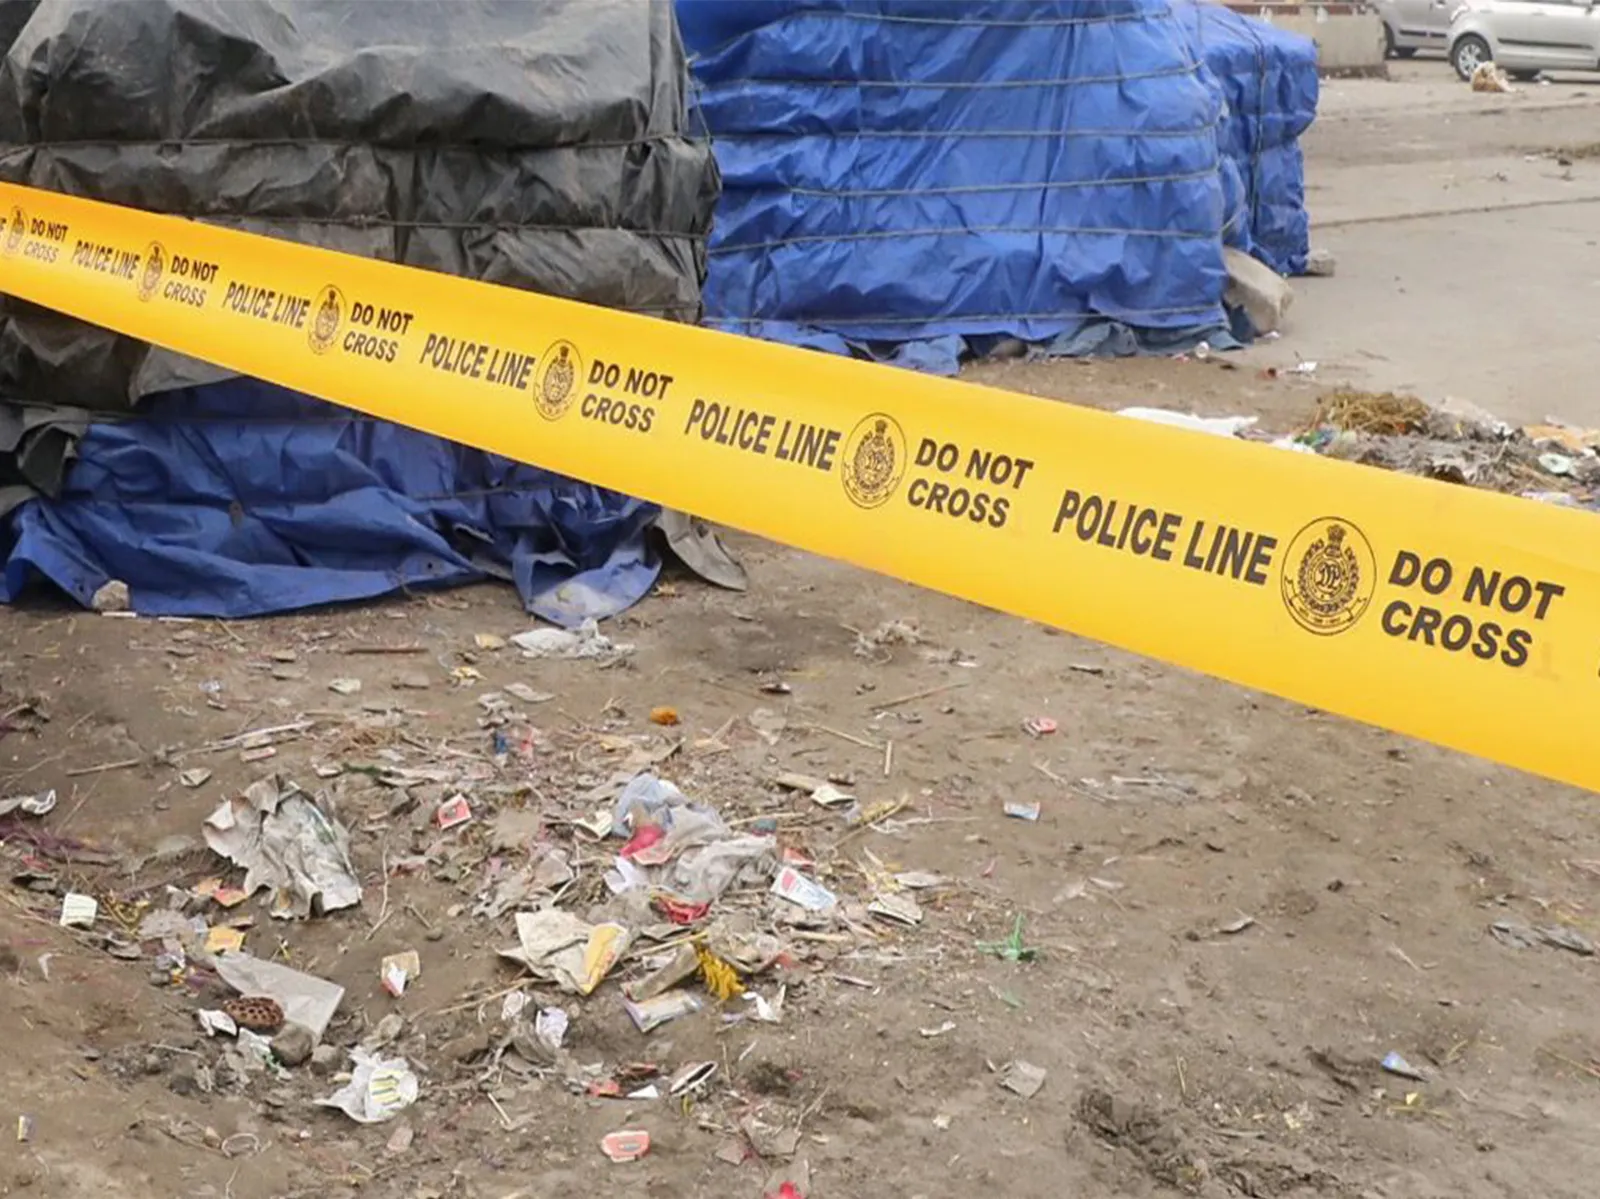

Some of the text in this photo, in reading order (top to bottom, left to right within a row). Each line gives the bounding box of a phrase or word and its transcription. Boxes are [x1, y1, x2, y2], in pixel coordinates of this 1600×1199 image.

[31, 218, 69, 242] DO NOT
[71, 240, 141, 280] POLICE LINE
[171, 255, 219, 284] DO NOT
[164, 281, 207, 307] CROSS
[222, 281, 311, 328] POLICE LINE
[350, 302, 414, 335] DO NOT
[343, 331, 399, 363] CROSS
[419, 333, 536, 391] POLICE LINE
[588, 359, 673, 400] DO NOT
[580, 393, 656, 433] CROSS
[684, 399, 841, 471] POLICE LINE
[915, 438, 1034, 489] DO NOT
[907, 478, 1010, 529] CROSS
[1052, 490, 1183, 561] POLICE
[1183, 520, 1278, 585] LINE
[1388, 550, 1453, 595] DO
[1462, 566, 1566, 620] NOT
[1381, 600, 1533, 668] CROSS
